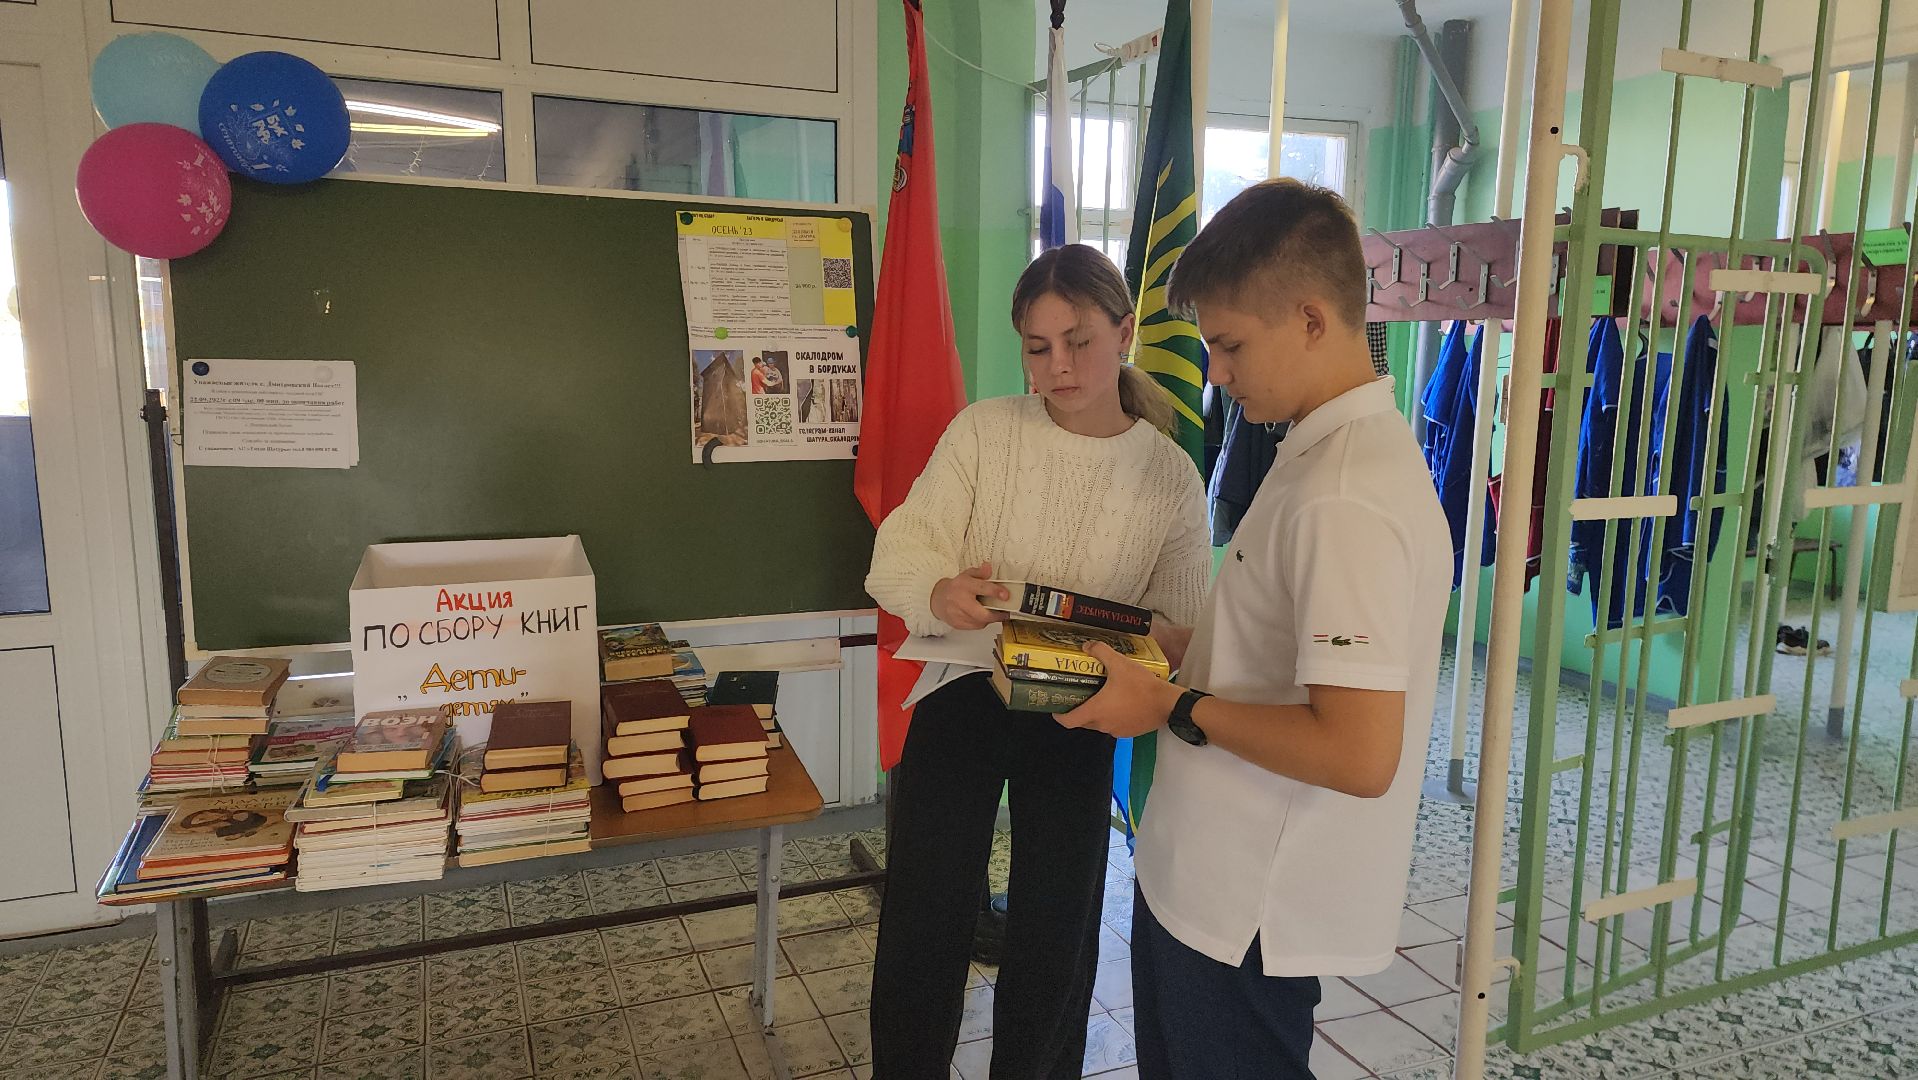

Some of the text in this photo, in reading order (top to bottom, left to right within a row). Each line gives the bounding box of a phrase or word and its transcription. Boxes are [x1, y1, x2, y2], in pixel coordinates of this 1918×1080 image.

[795, 351, 844, 362] СКАЛОДРОМ
[809, 364, 857, 374] В БОРДУКАХ
[436, 588, 513, 612] Акция
[363, 605, 588, 651] ПО СБОРУ КНИГ
